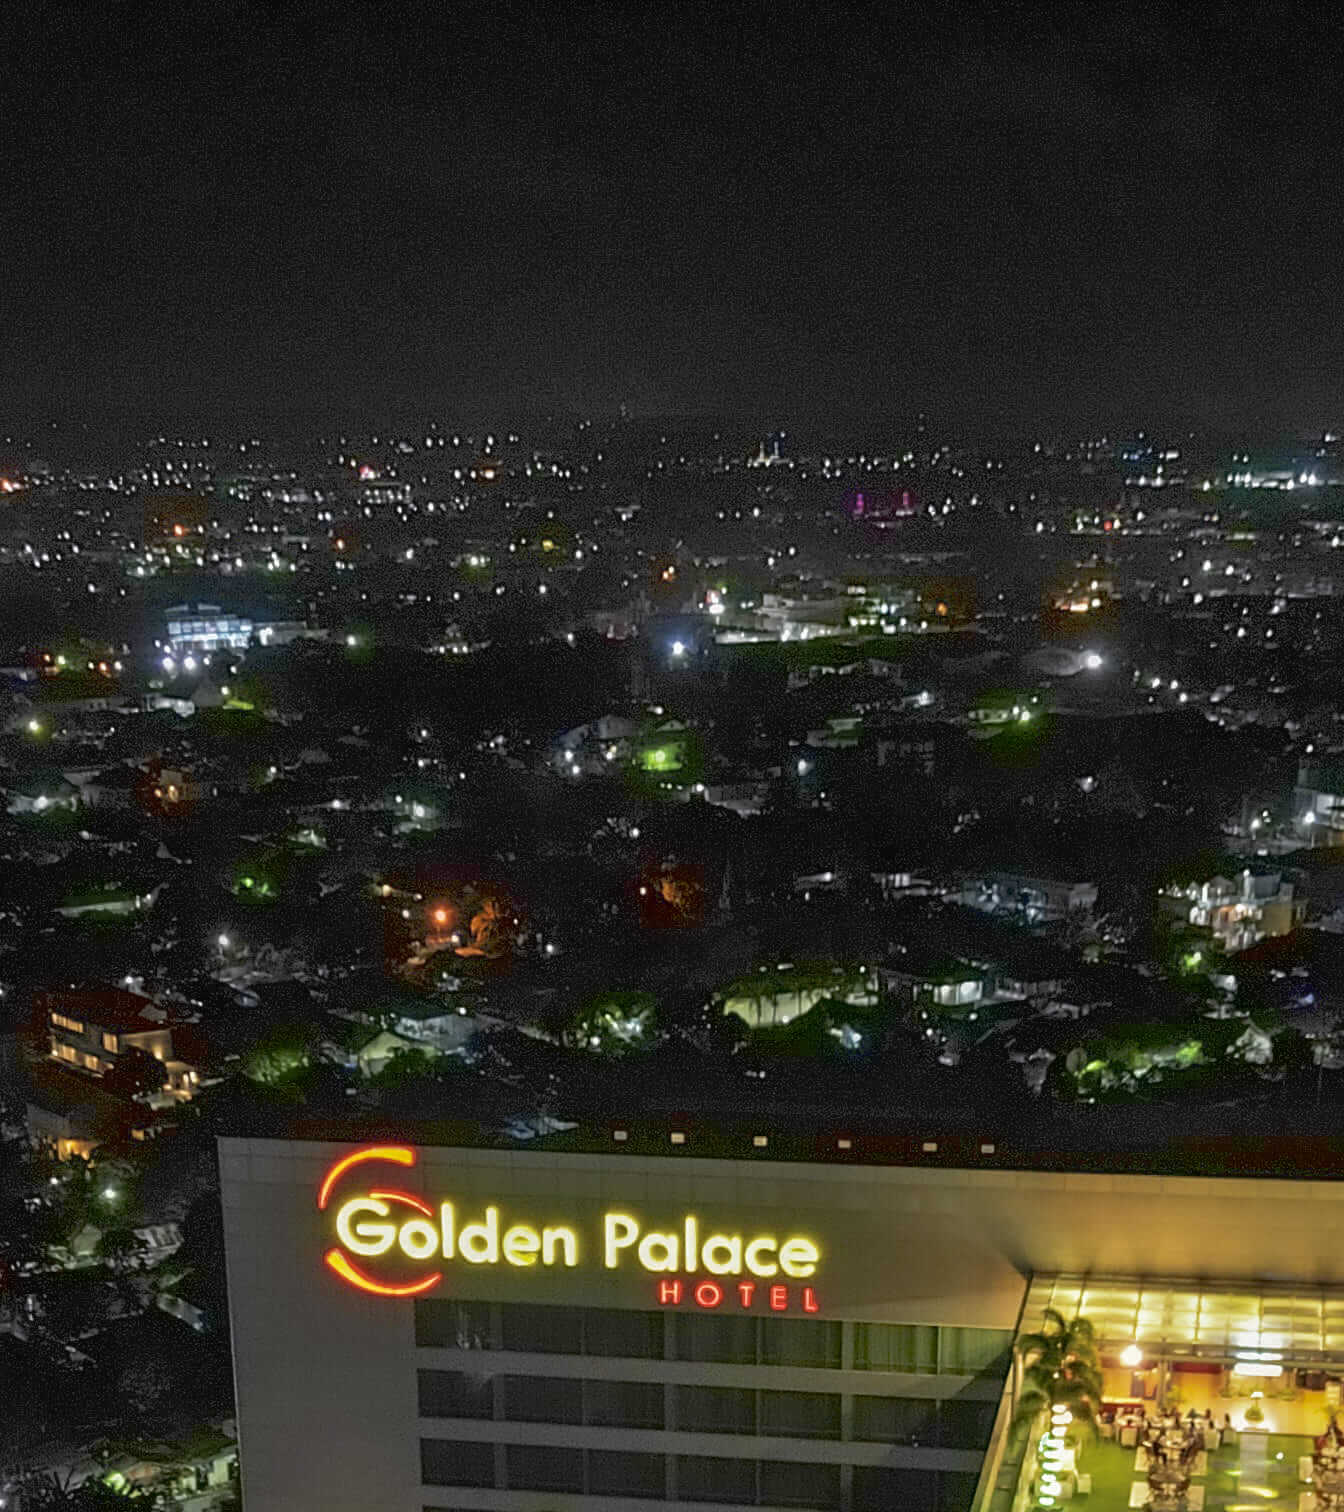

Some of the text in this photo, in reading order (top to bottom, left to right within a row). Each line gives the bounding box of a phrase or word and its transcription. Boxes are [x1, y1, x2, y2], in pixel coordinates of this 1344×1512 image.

[336, 1198, 819, 1277] Golden Palace
[660, 1280, 819, 1313] HOTEL
